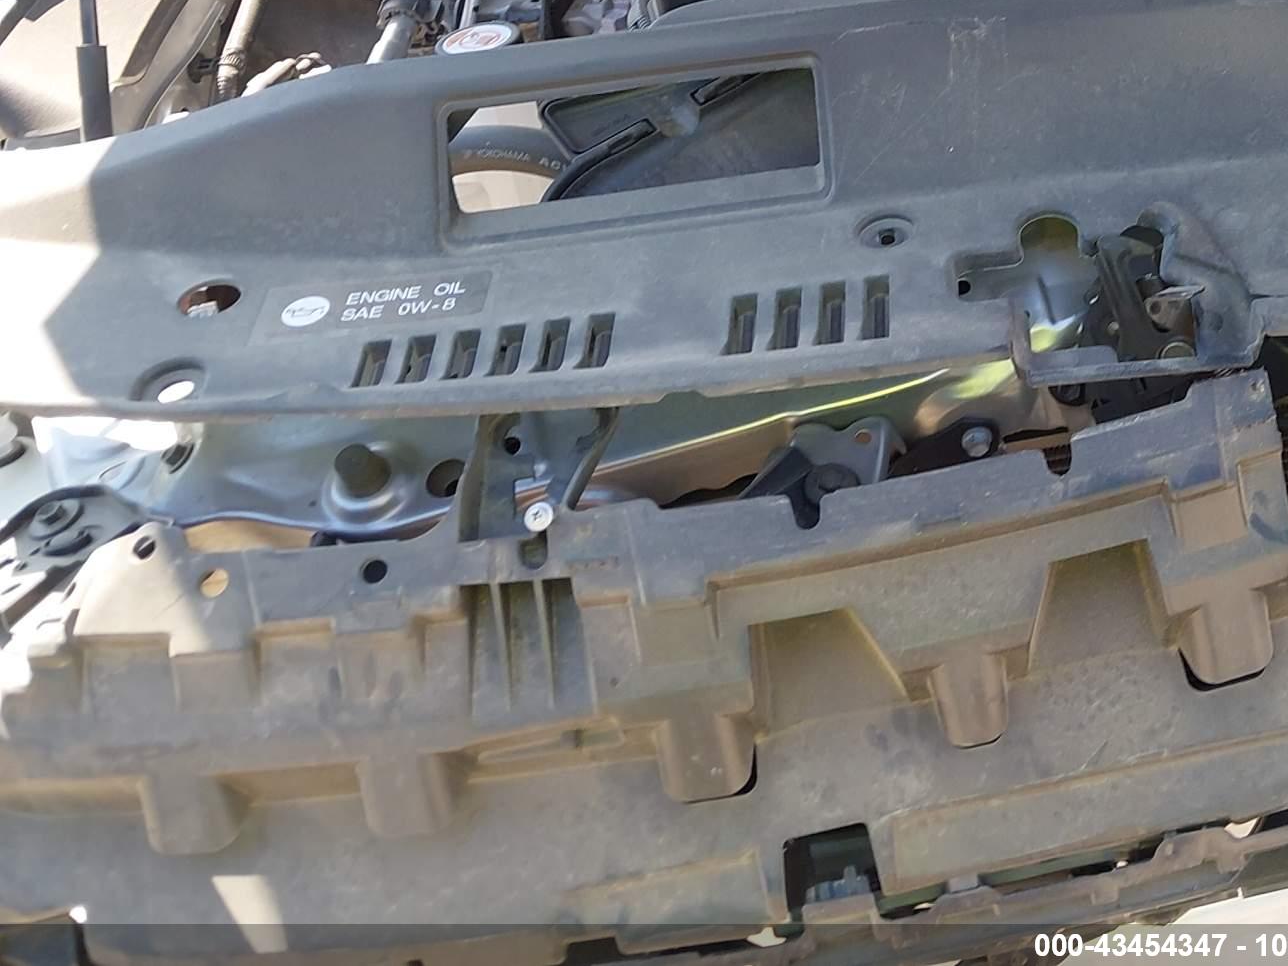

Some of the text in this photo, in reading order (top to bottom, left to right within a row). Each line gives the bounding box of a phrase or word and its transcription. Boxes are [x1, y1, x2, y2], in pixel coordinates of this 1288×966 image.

[345, 281, 466, 306] ENGINE OIL
[340, 297, 456, 322] SAE 0W-8
